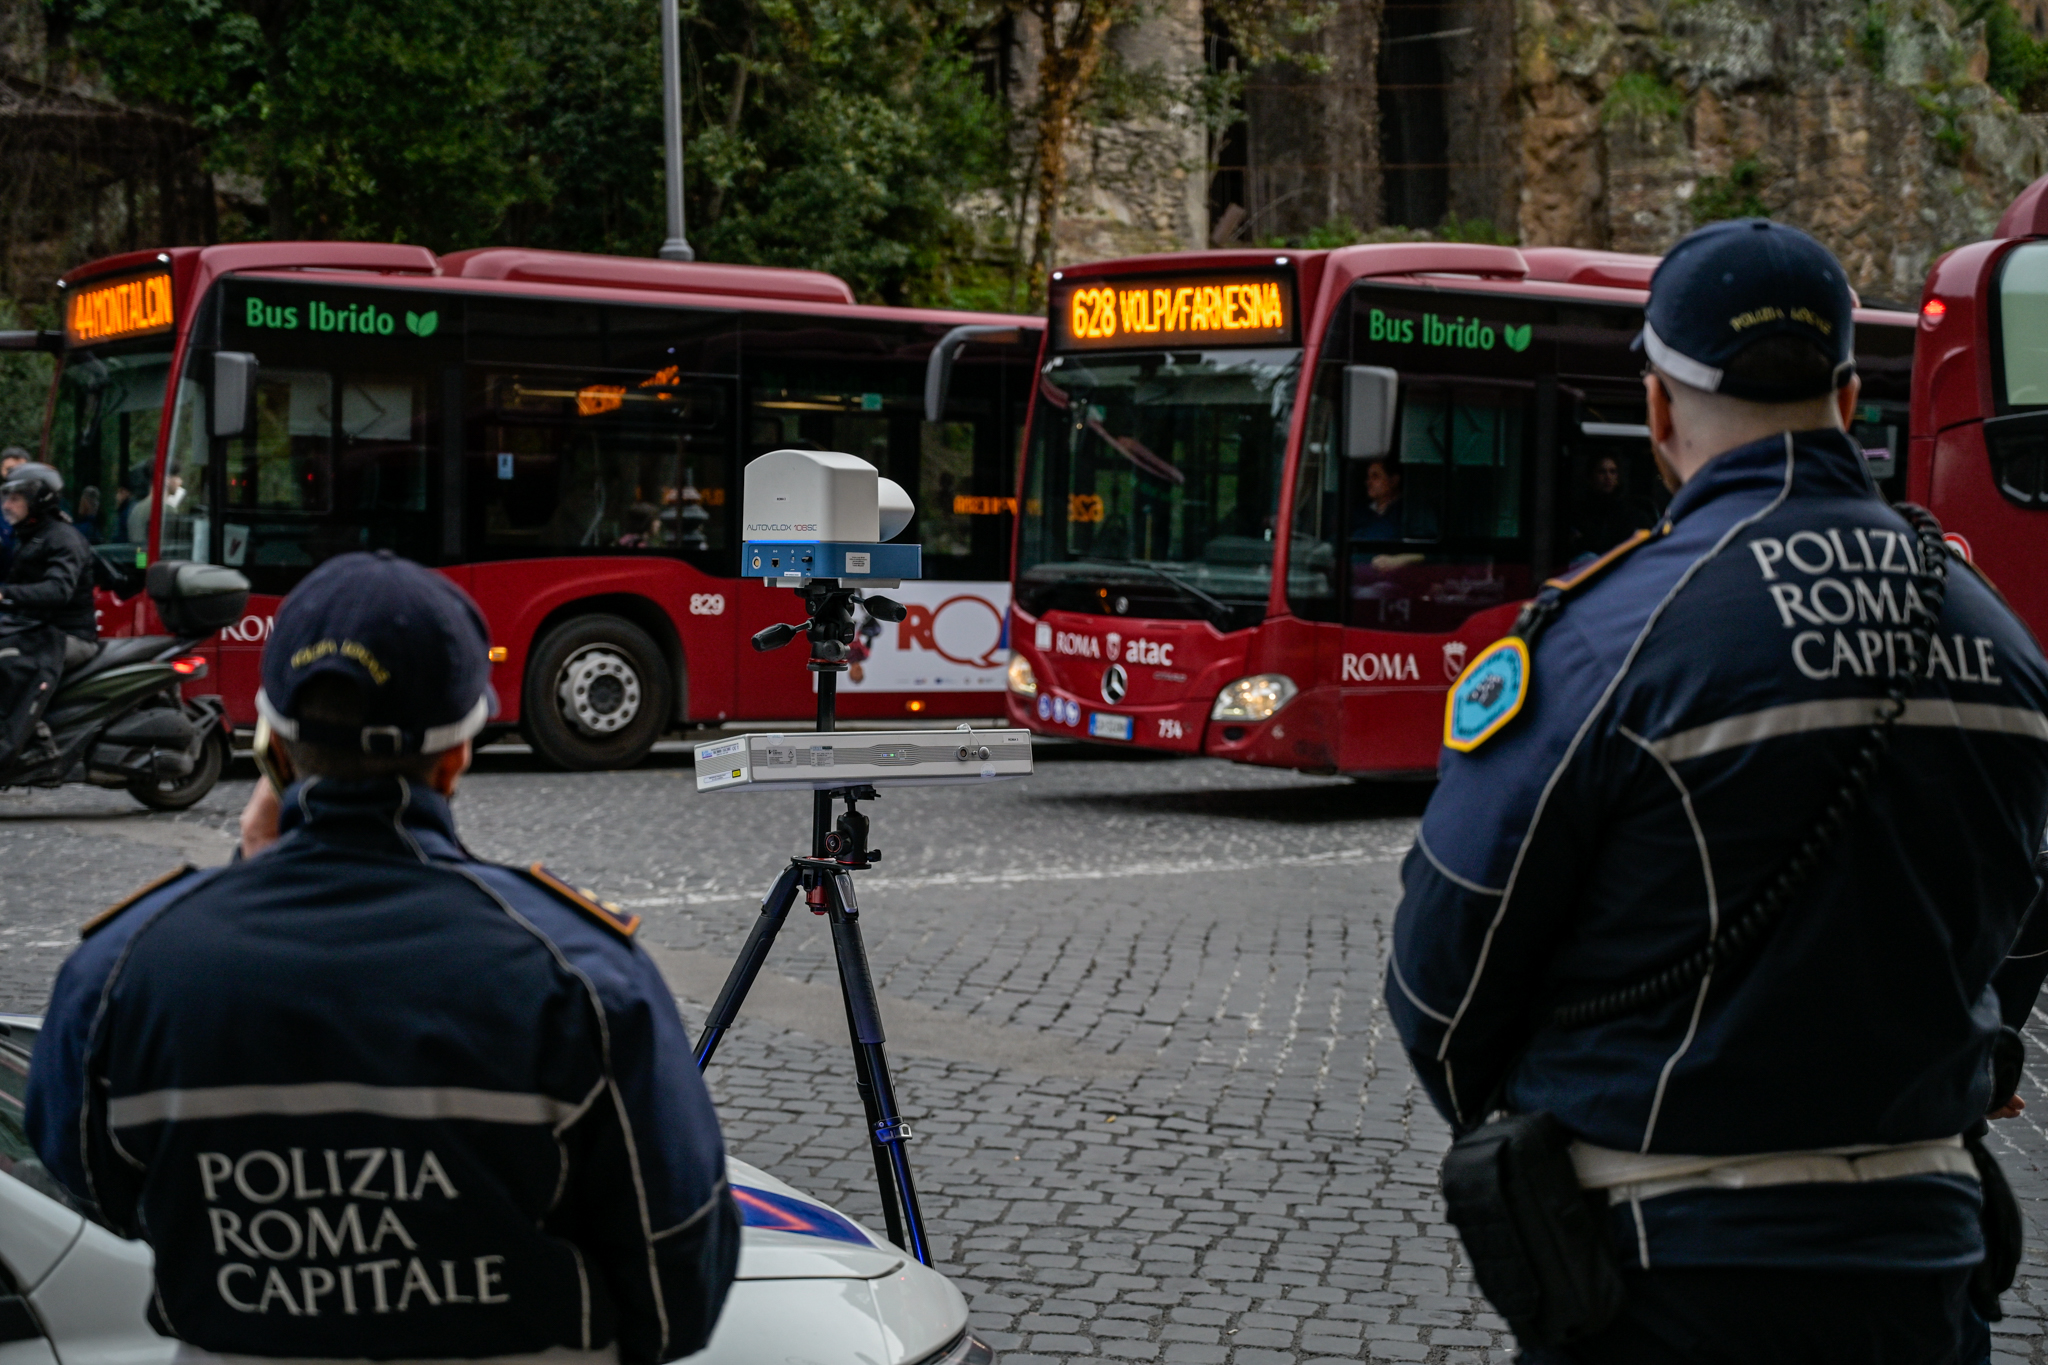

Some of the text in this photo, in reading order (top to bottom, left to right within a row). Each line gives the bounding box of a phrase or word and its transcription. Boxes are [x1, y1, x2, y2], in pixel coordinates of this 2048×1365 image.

[246, 297, 395, 335] Bus Ibrido
[1072, 282, 1283, 338] 628 VOLPI/FARNESINA
[1369, 308, 1495, 350] Bus Ibrido
[747, 524, 791, 532] AUTOVELOX
[1748, 528, 1926, 581] POLIZI
[689, 593, 725, 616] 829
[1056, 631, 1101, 659] ROMA
[1125, 637, 1174, 666] atac
[1341, 652, 1420, 681] ROMA
[197, 1147, 460, 1204] POLIZIA
[208, 1203, 419, 1260] ROMA
[216, 1254, 510, 1316] CAPITALE
